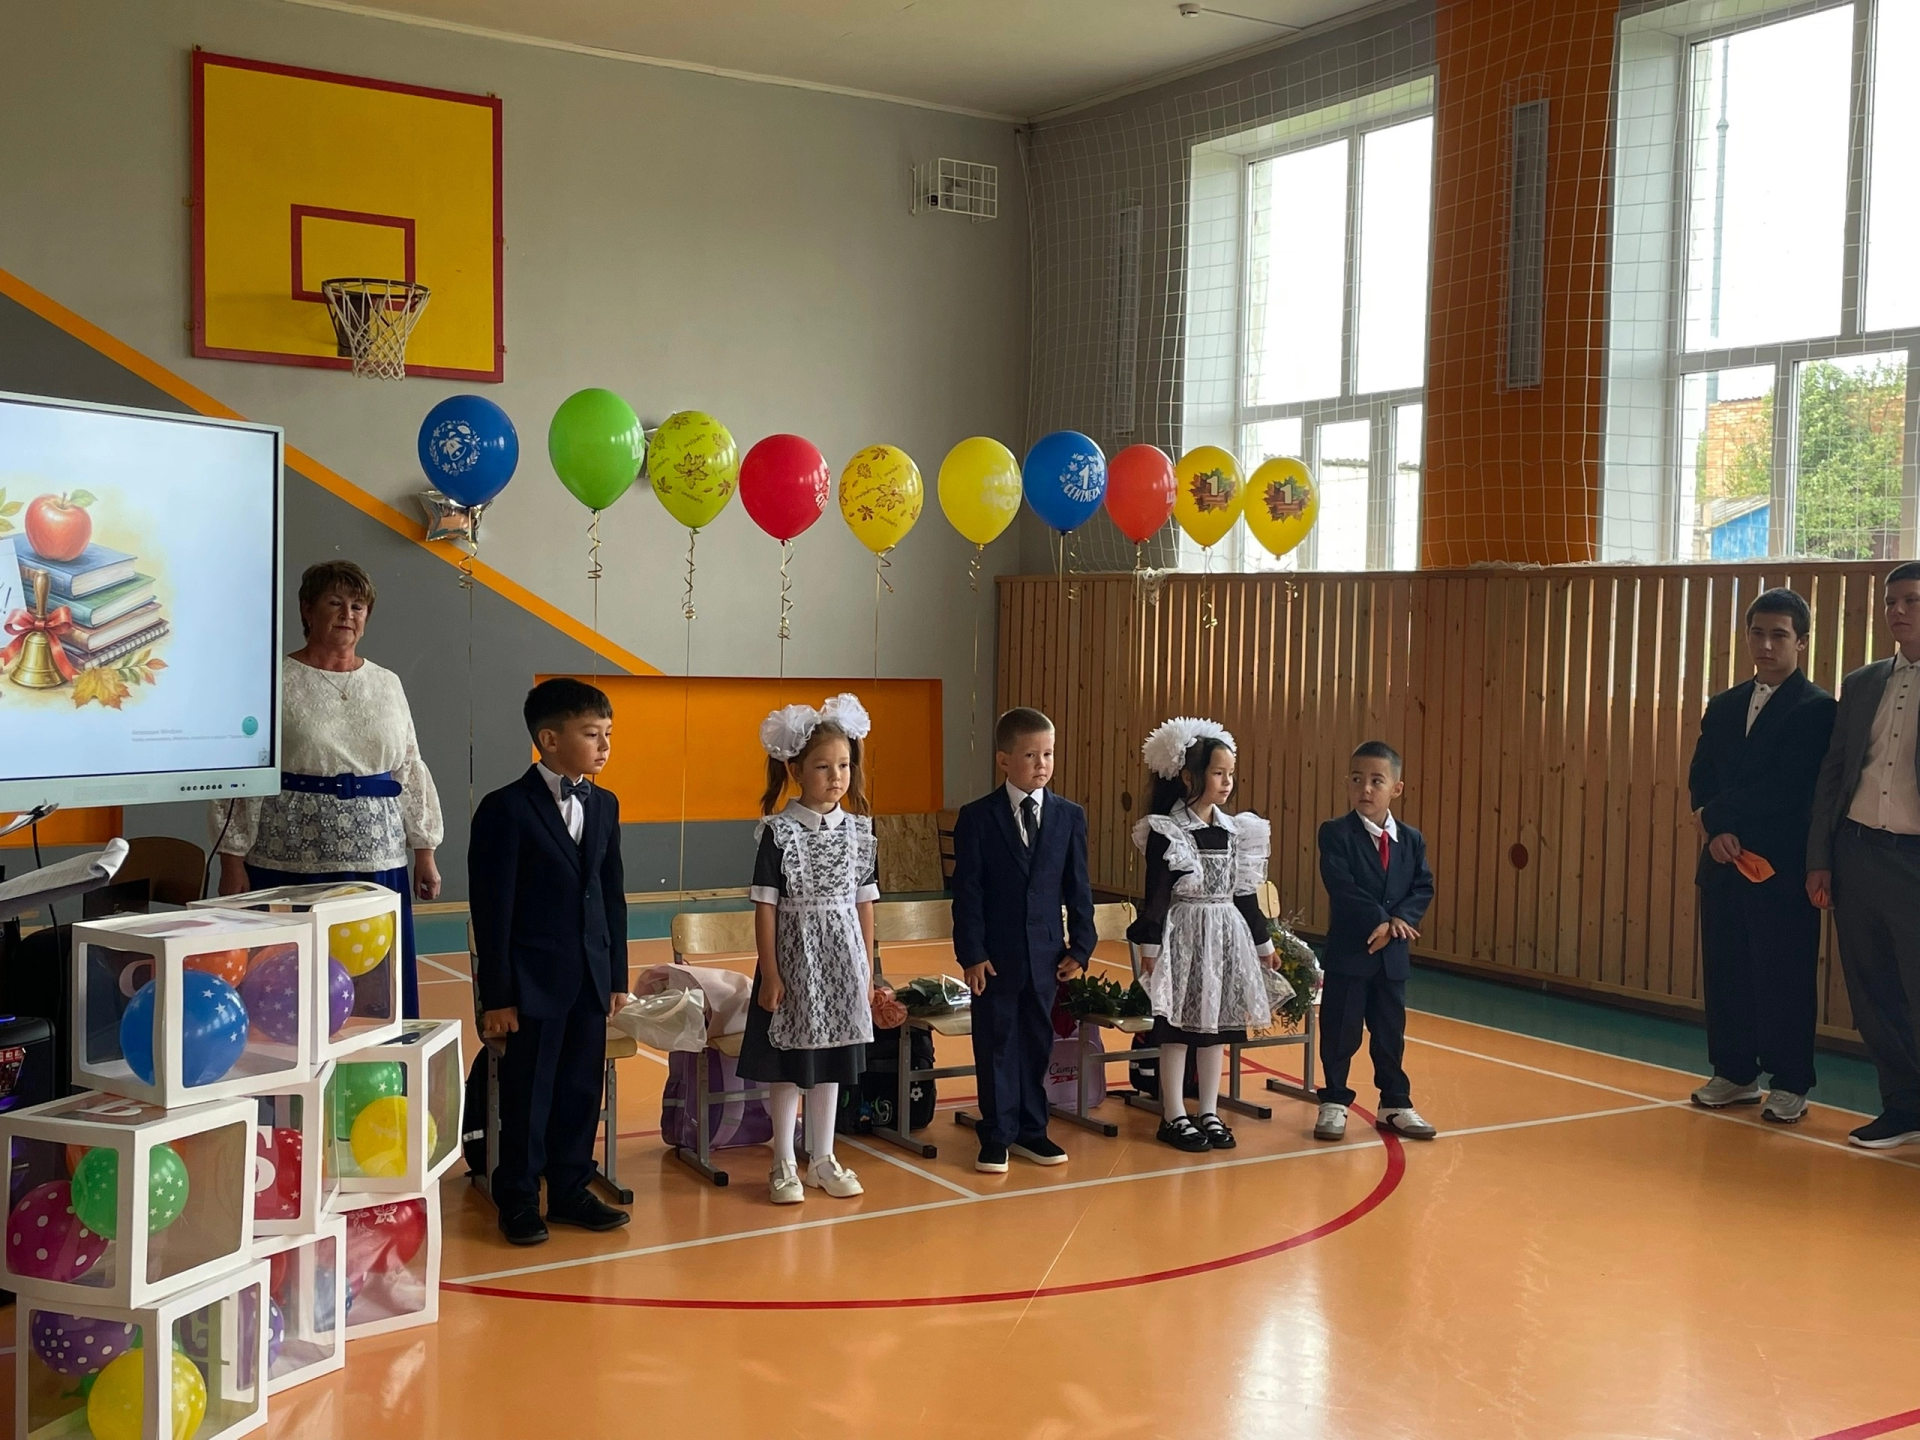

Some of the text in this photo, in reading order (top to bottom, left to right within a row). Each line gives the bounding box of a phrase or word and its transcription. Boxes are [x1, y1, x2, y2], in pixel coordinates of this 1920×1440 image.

[1079, 464, 1090, 490] 1
[1207, 475, 1218, 496] 1
[1063, 483, 1101, 502] СЕНТЯБРЯ
[1280, 484, 1292, 504] 1
[1049, 1061, 1078, 1076] Camp
